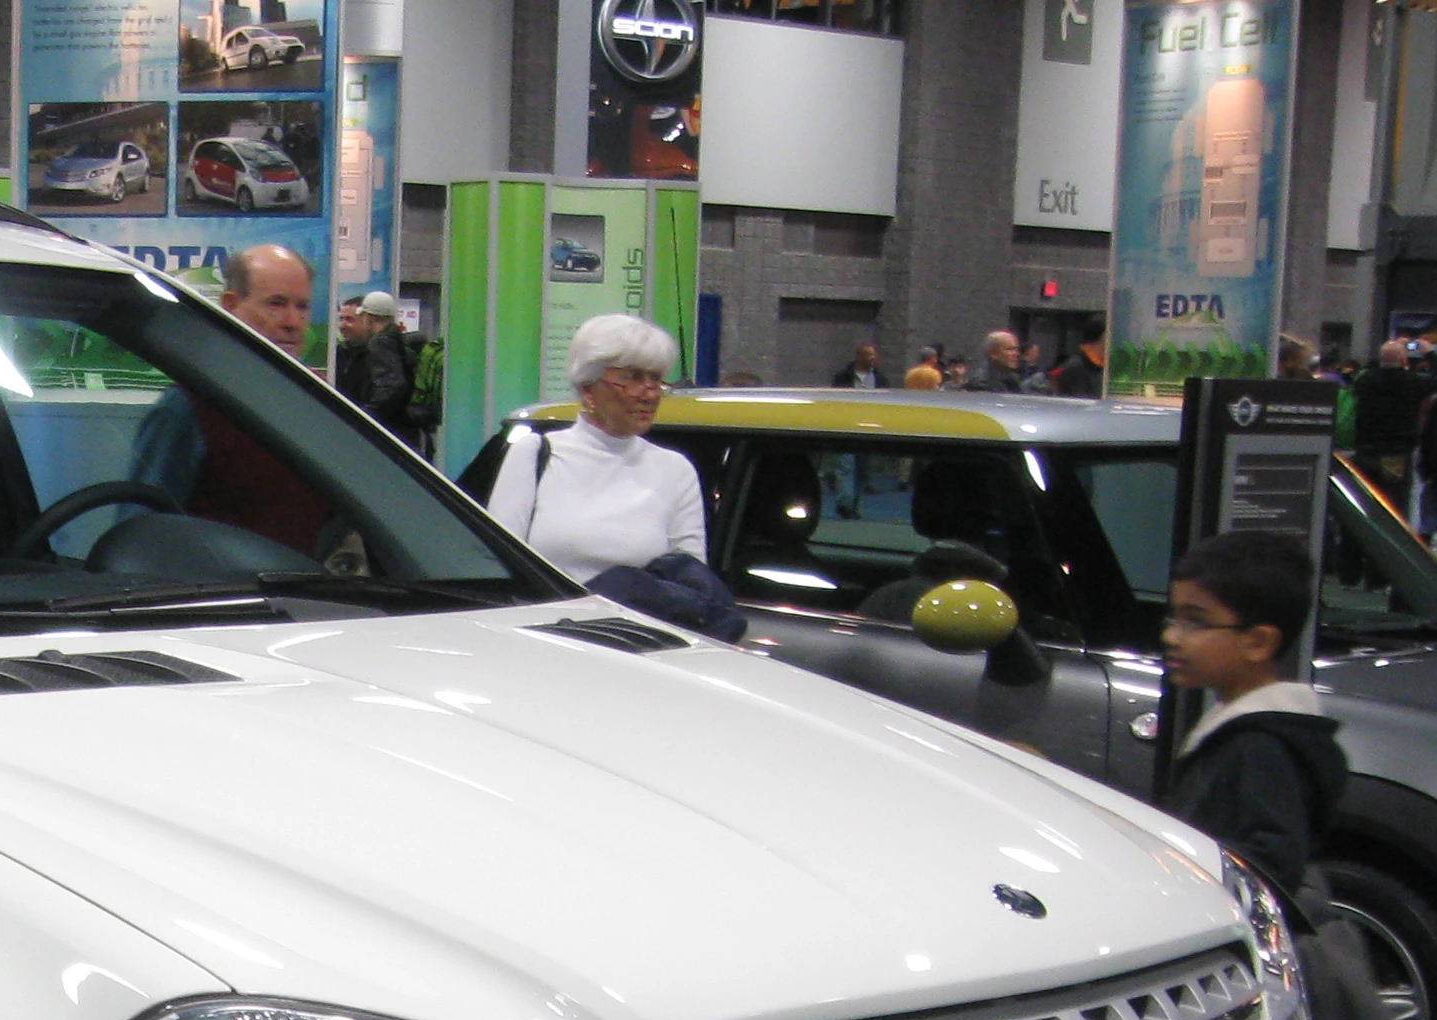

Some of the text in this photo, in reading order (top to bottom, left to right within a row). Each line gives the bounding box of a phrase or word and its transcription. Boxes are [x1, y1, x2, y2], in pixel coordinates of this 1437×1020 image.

[1140, 9, 1279, 54] Fuel Cell
[1039, 179, 1080, 216] Exit
[1156, 295, 1227, 319] EDTA
